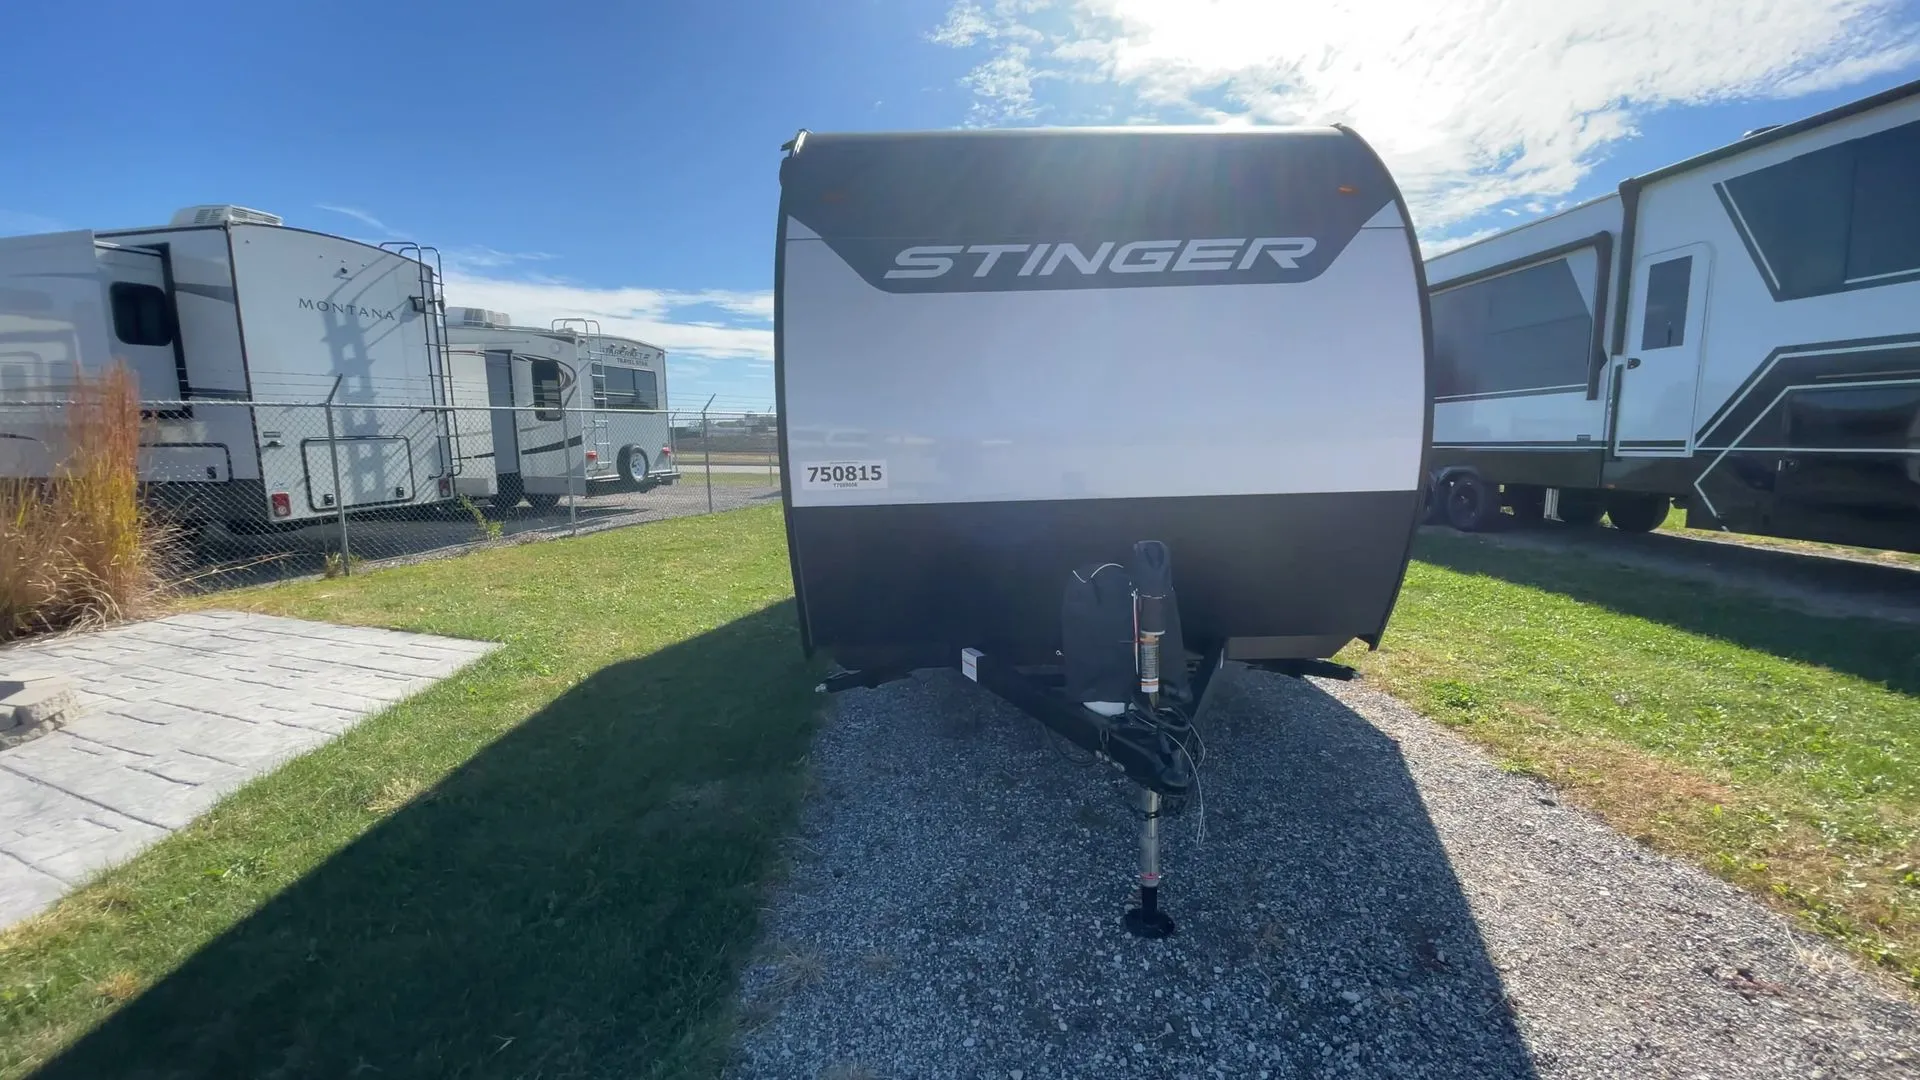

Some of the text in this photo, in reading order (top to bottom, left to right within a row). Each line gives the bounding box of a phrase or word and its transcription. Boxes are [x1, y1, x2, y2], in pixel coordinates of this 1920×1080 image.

[883, 236, 1317, 279] STINGER
[298, 298, 395, 321] MONTANA
[807, 465, 882, 482] 750815
